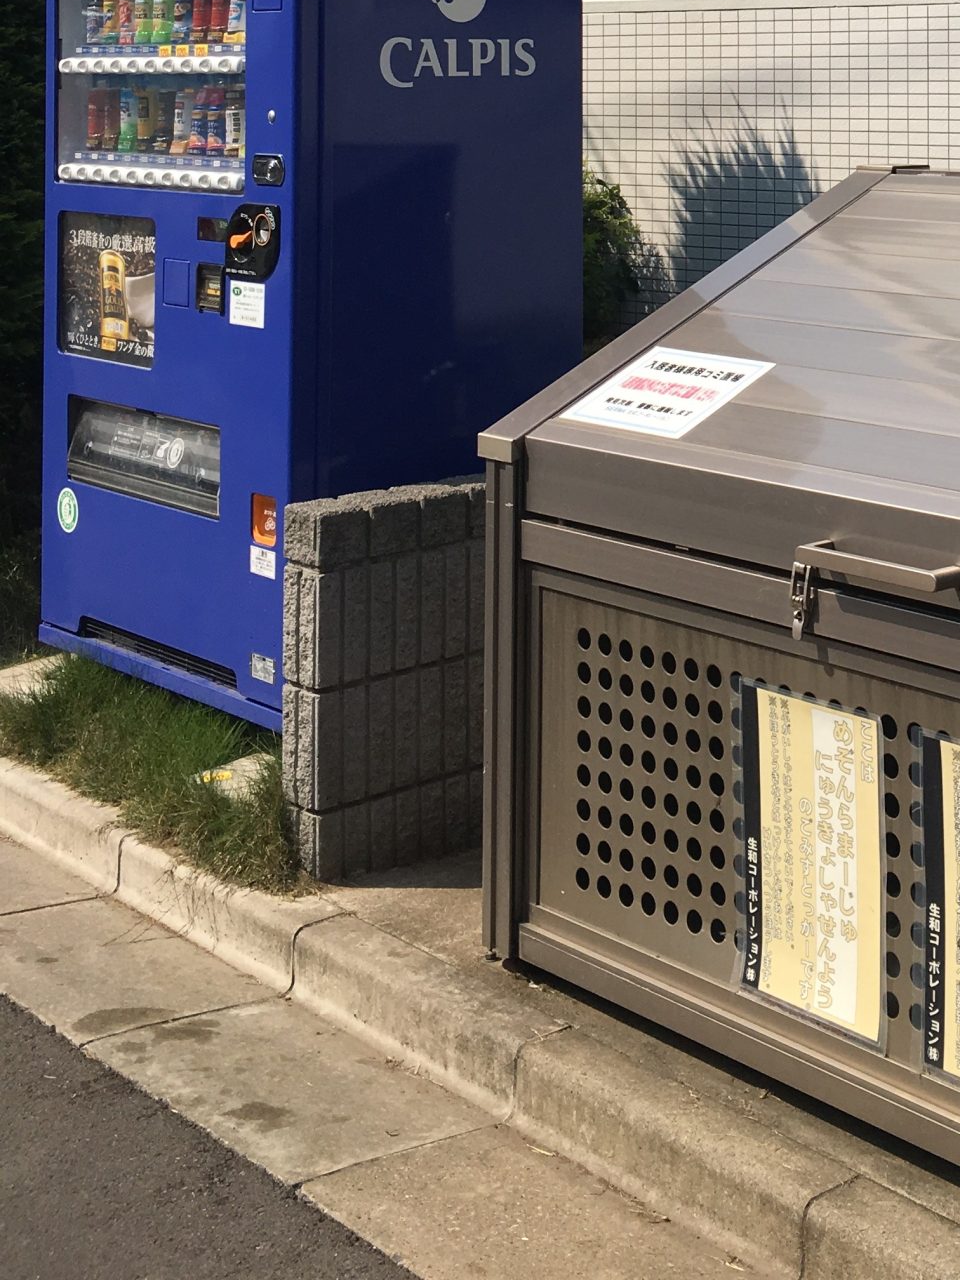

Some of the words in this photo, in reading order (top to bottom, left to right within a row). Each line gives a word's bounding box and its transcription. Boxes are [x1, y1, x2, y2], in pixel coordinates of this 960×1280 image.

[379, 36, 537, 89] CALPIS
[860, 719, 875, 784] ここは
[815, 749, 838, 1009] にゅうきょしゃせんよう
[833, 719, 859, 944] めぞんらまーじゅ
